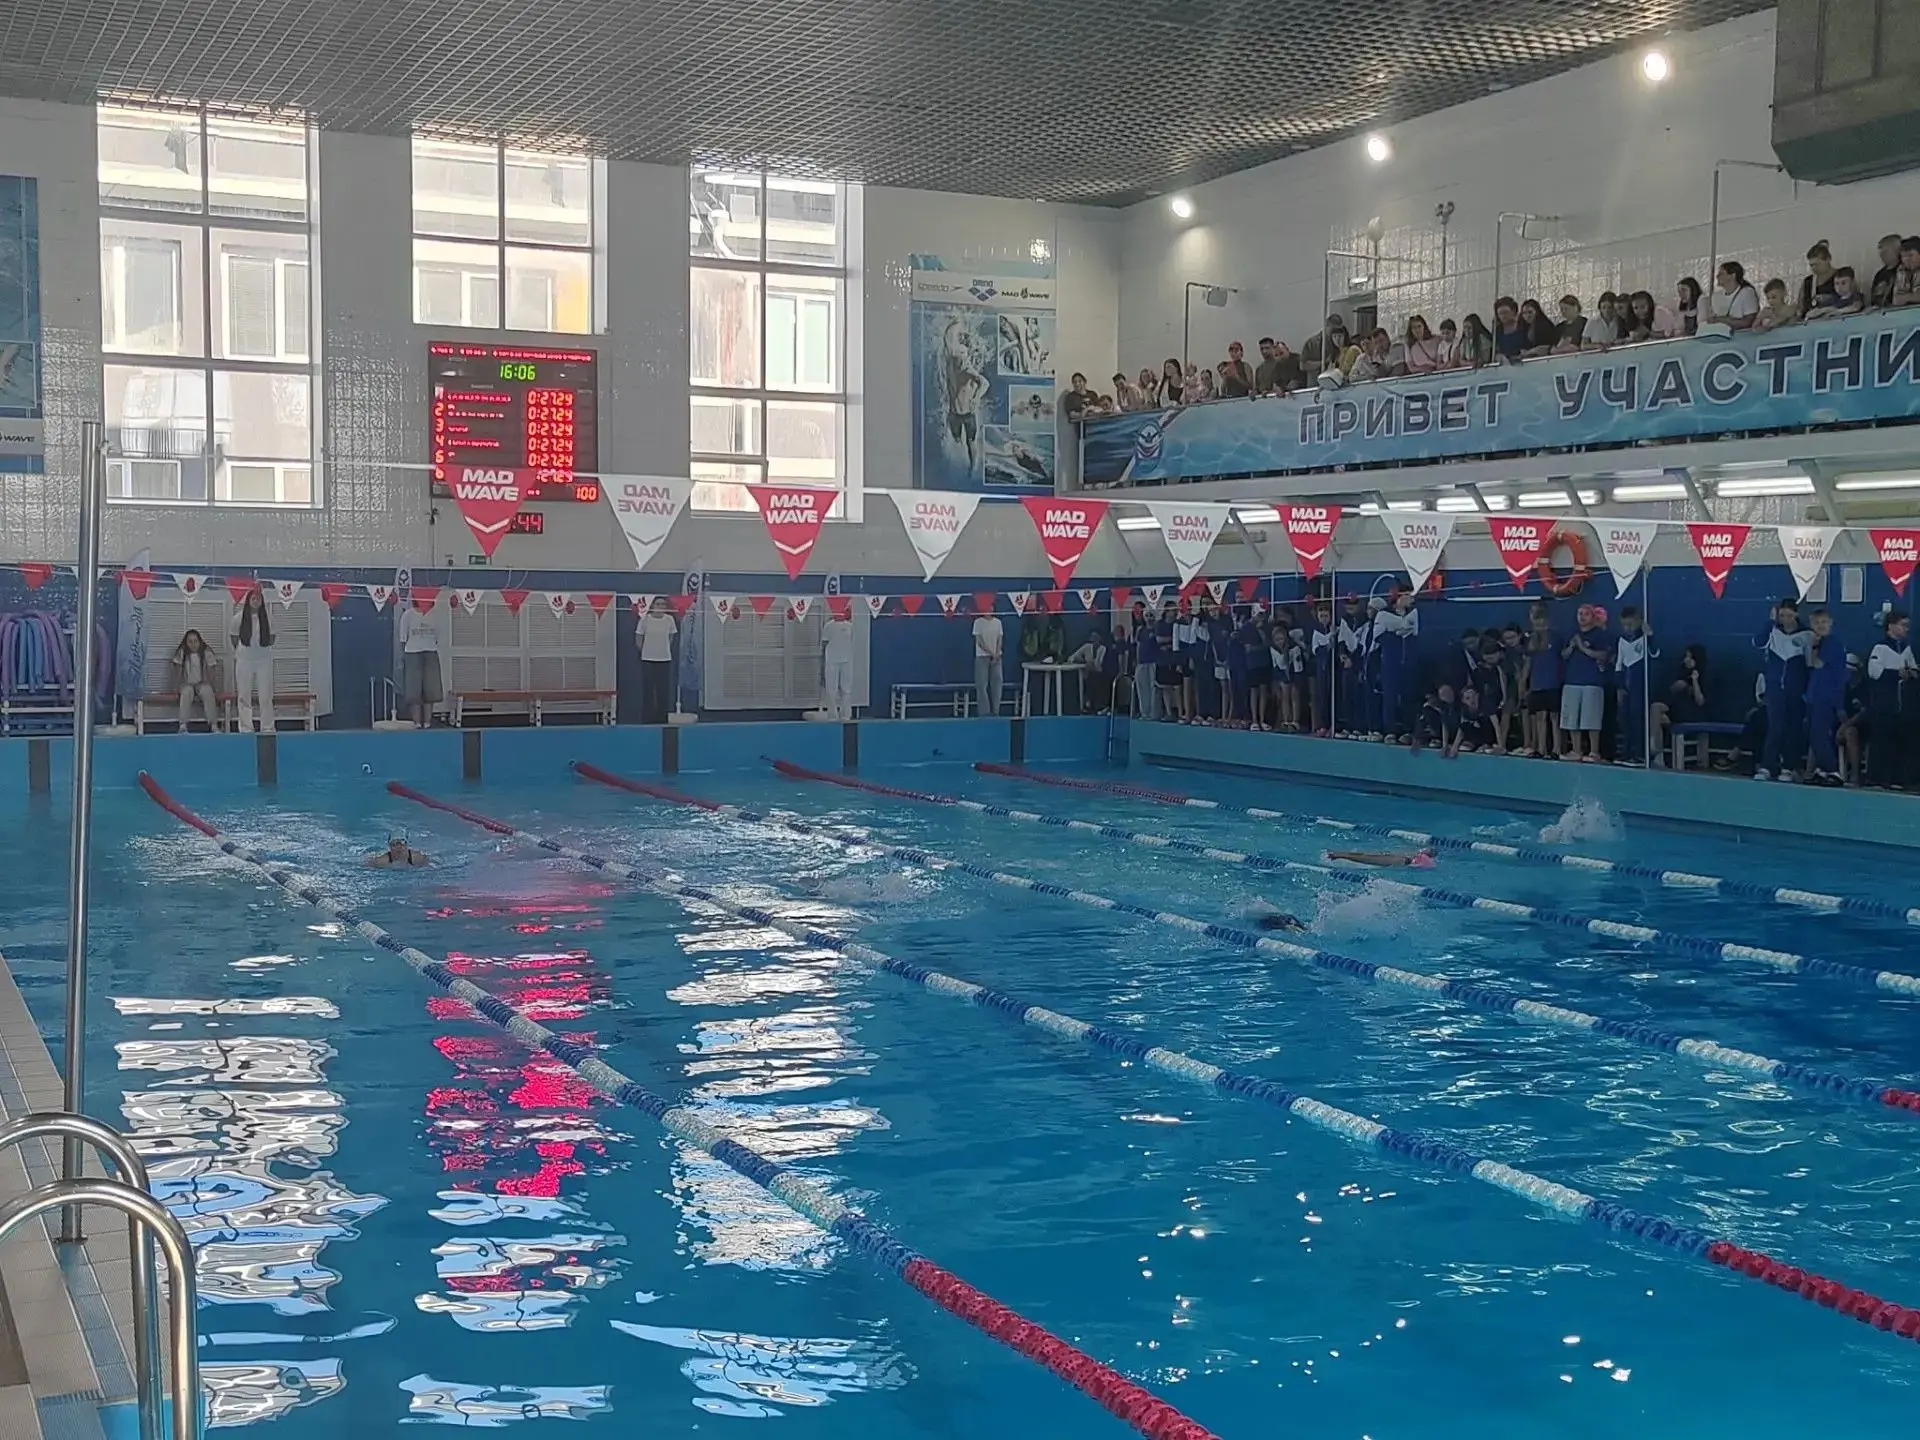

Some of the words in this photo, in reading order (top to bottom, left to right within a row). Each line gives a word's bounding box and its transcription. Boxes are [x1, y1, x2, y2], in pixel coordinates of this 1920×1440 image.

[500, 364, 535, 380] 16:06
[435, 402, 444, 416] 2
[1299, 380, 1511, 445] ПРИВЕТ
[435, 418, 444, 432] 3
[435, 434, 444, 446] 4
[462, 468, 514, 484] MAD
[456, 484, 519, 501] WAVE
[576, 486, 597, 500] 100
[770, 494, 815, 509] MAD
[766, 509, 818, 524] WAVE
[1045, 509, 1086, 524] MAD
[1291, 507, 1327, 521] MAD
[1042, 524, 1090, 539] WAVE
[1288, 520, 1331, 534] WAVE
[1503, 526, 1536, 538] MAD
[1500, 538, 1540, 551] WAVE
[1702, 533, 1732, 545] MAD
[1883, 538, 1914, 549] MAD
[1701, 546, 1734, 558] WAVE
[1880, 550, 1918, 561] WAVE
